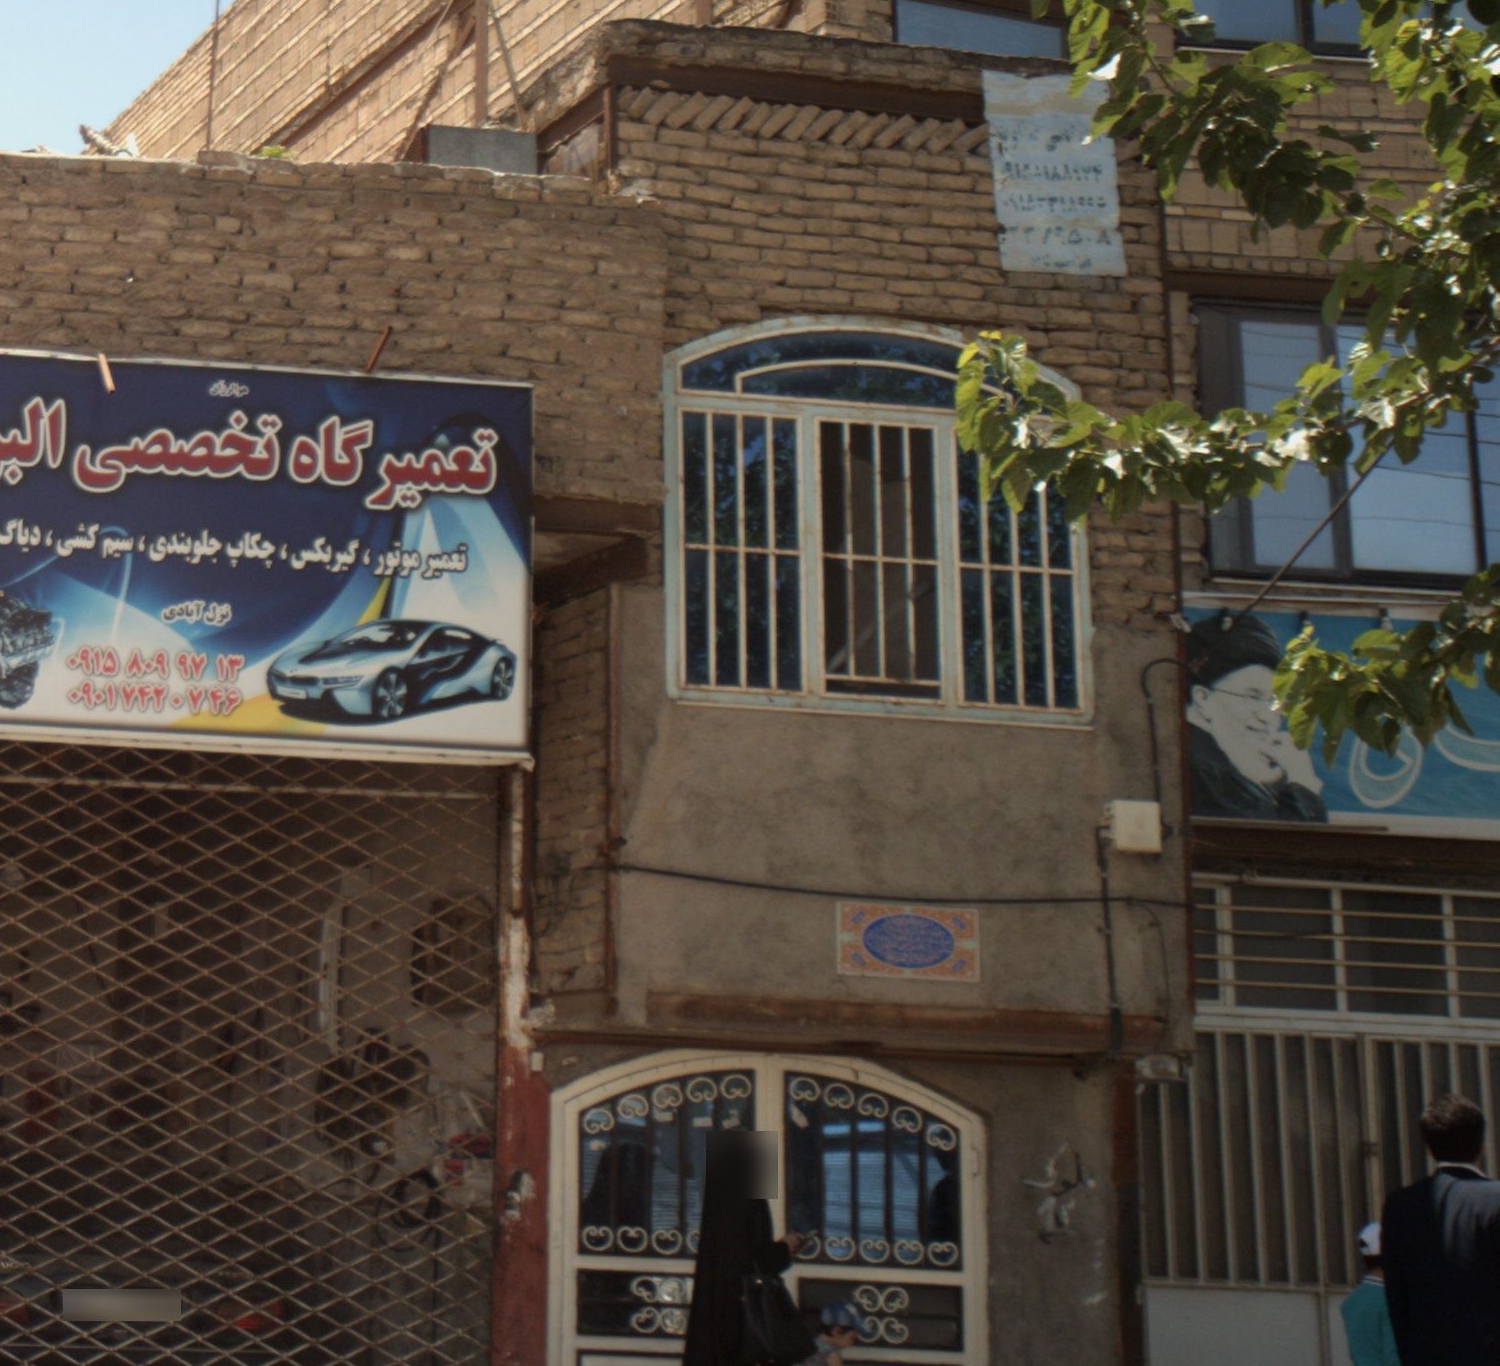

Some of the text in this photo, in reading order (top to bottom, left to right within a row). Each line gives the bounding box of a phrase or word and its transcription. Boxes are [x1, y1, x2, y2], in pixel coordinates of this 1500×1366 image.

[73, 410, 283, 493] تخصصی
[148, 528, 222, 564] جلوبندی
[374, 541, 422, 577] موتور
[421, 542, 469, 579] تعمیر
